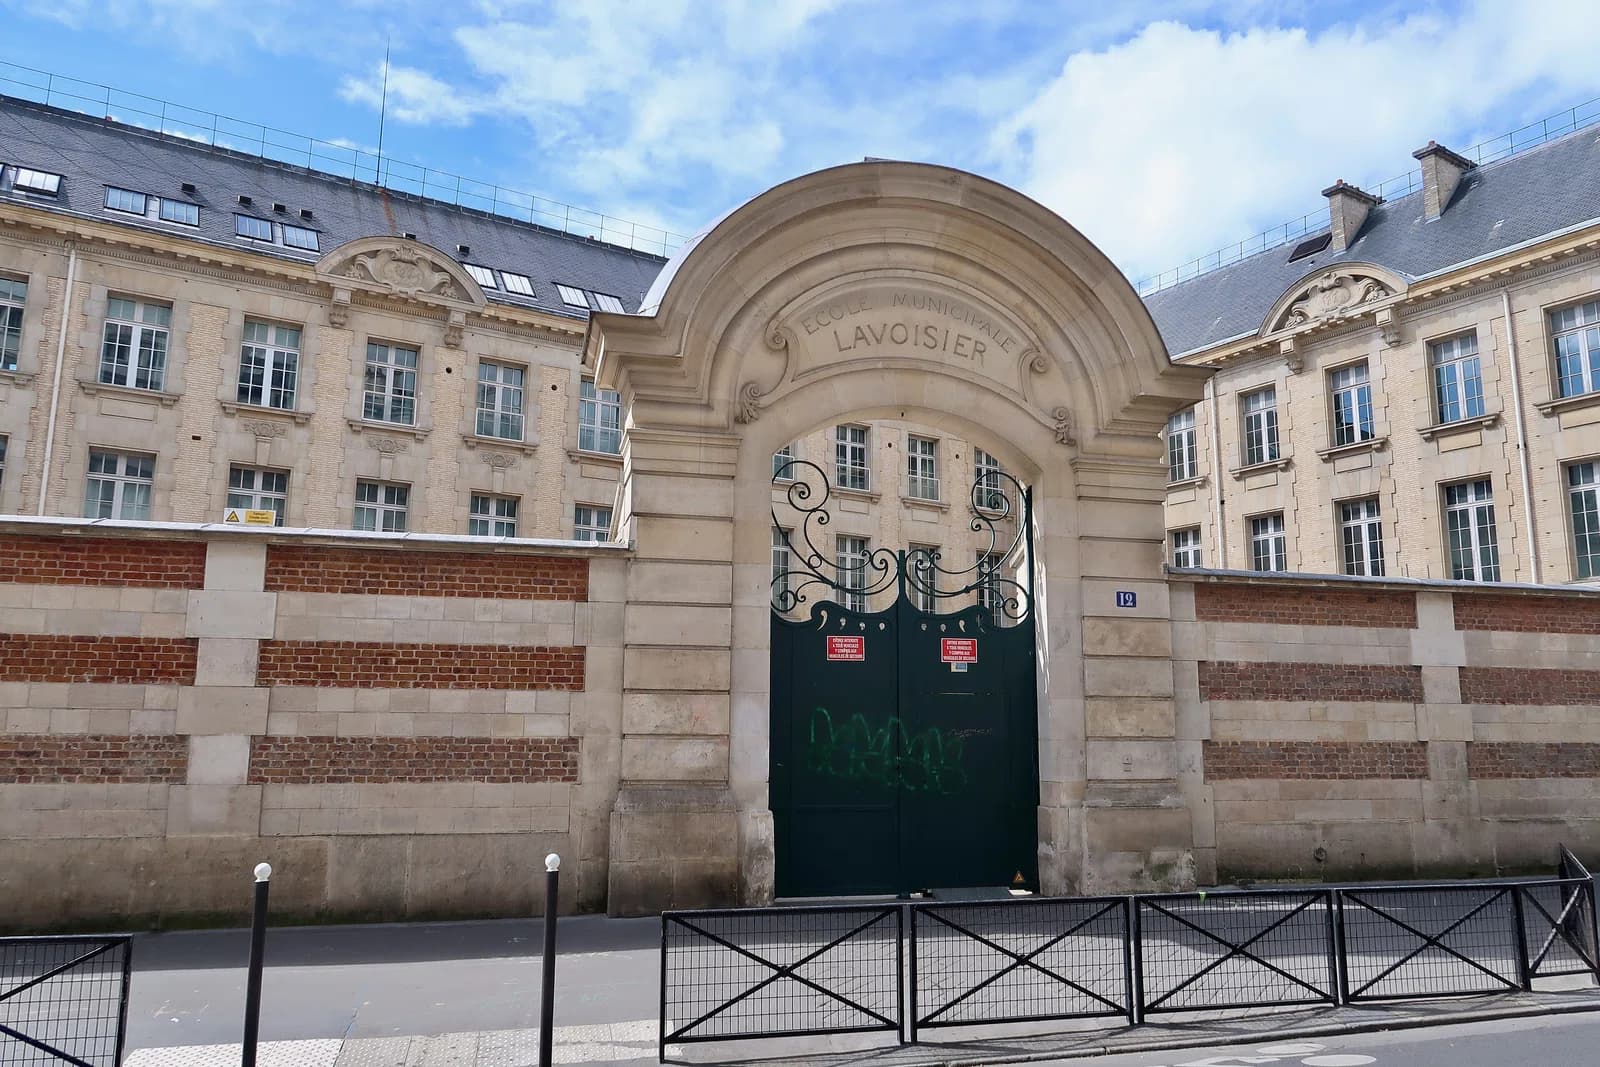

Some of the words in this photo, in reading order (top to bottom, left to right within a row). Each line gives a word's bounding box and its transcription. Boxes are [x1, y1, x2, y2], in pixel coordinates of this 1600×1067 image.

[801, 301, 873, 336] ECOLE
[892, 293, 1017, 354] MUNICIPALE
[833, 322, 987, 368] LAVOISIER
